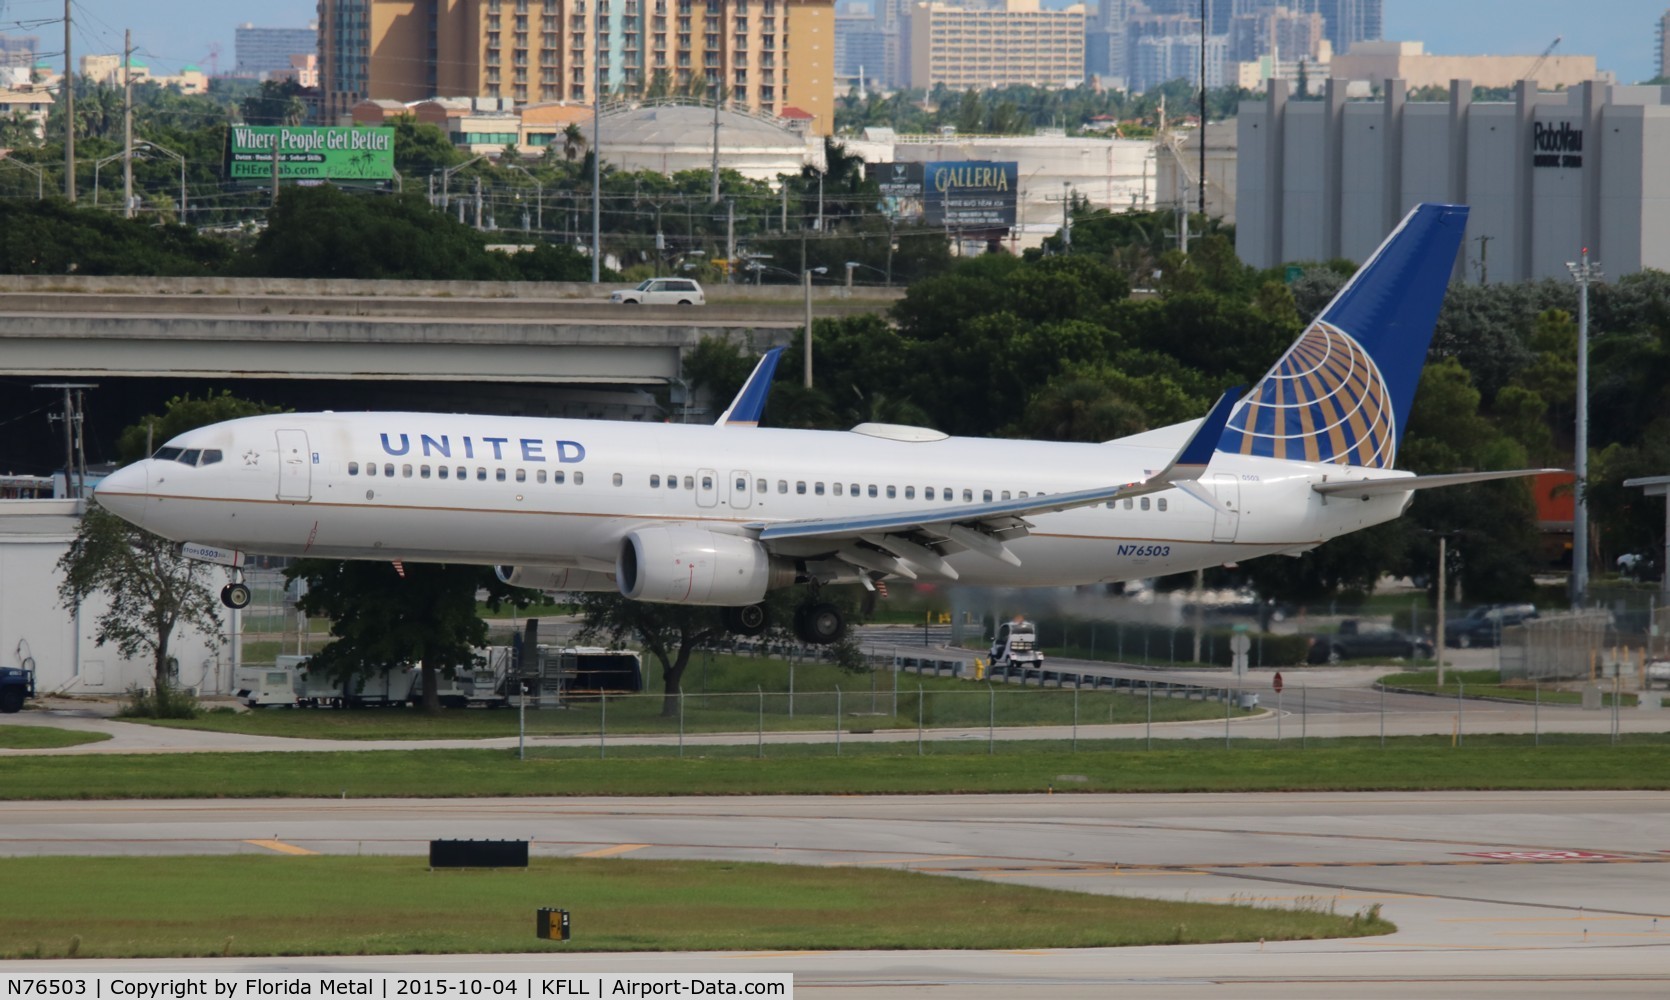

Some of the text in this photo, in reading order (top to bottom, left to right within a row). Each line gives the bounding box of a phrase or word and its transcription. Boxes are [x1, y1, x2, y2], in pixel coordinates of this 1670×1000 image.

[281, 129, 323, 152] People
[326, 130, 348, 150] Get
[350, 130, 389, 150] Better
[935, 167, 1008, 192] GALLERIA
[380, 433, 586, 463] UNITED
[200, 548, 219, 558] 0503
[1117, 544, 1170, 556] N76503
